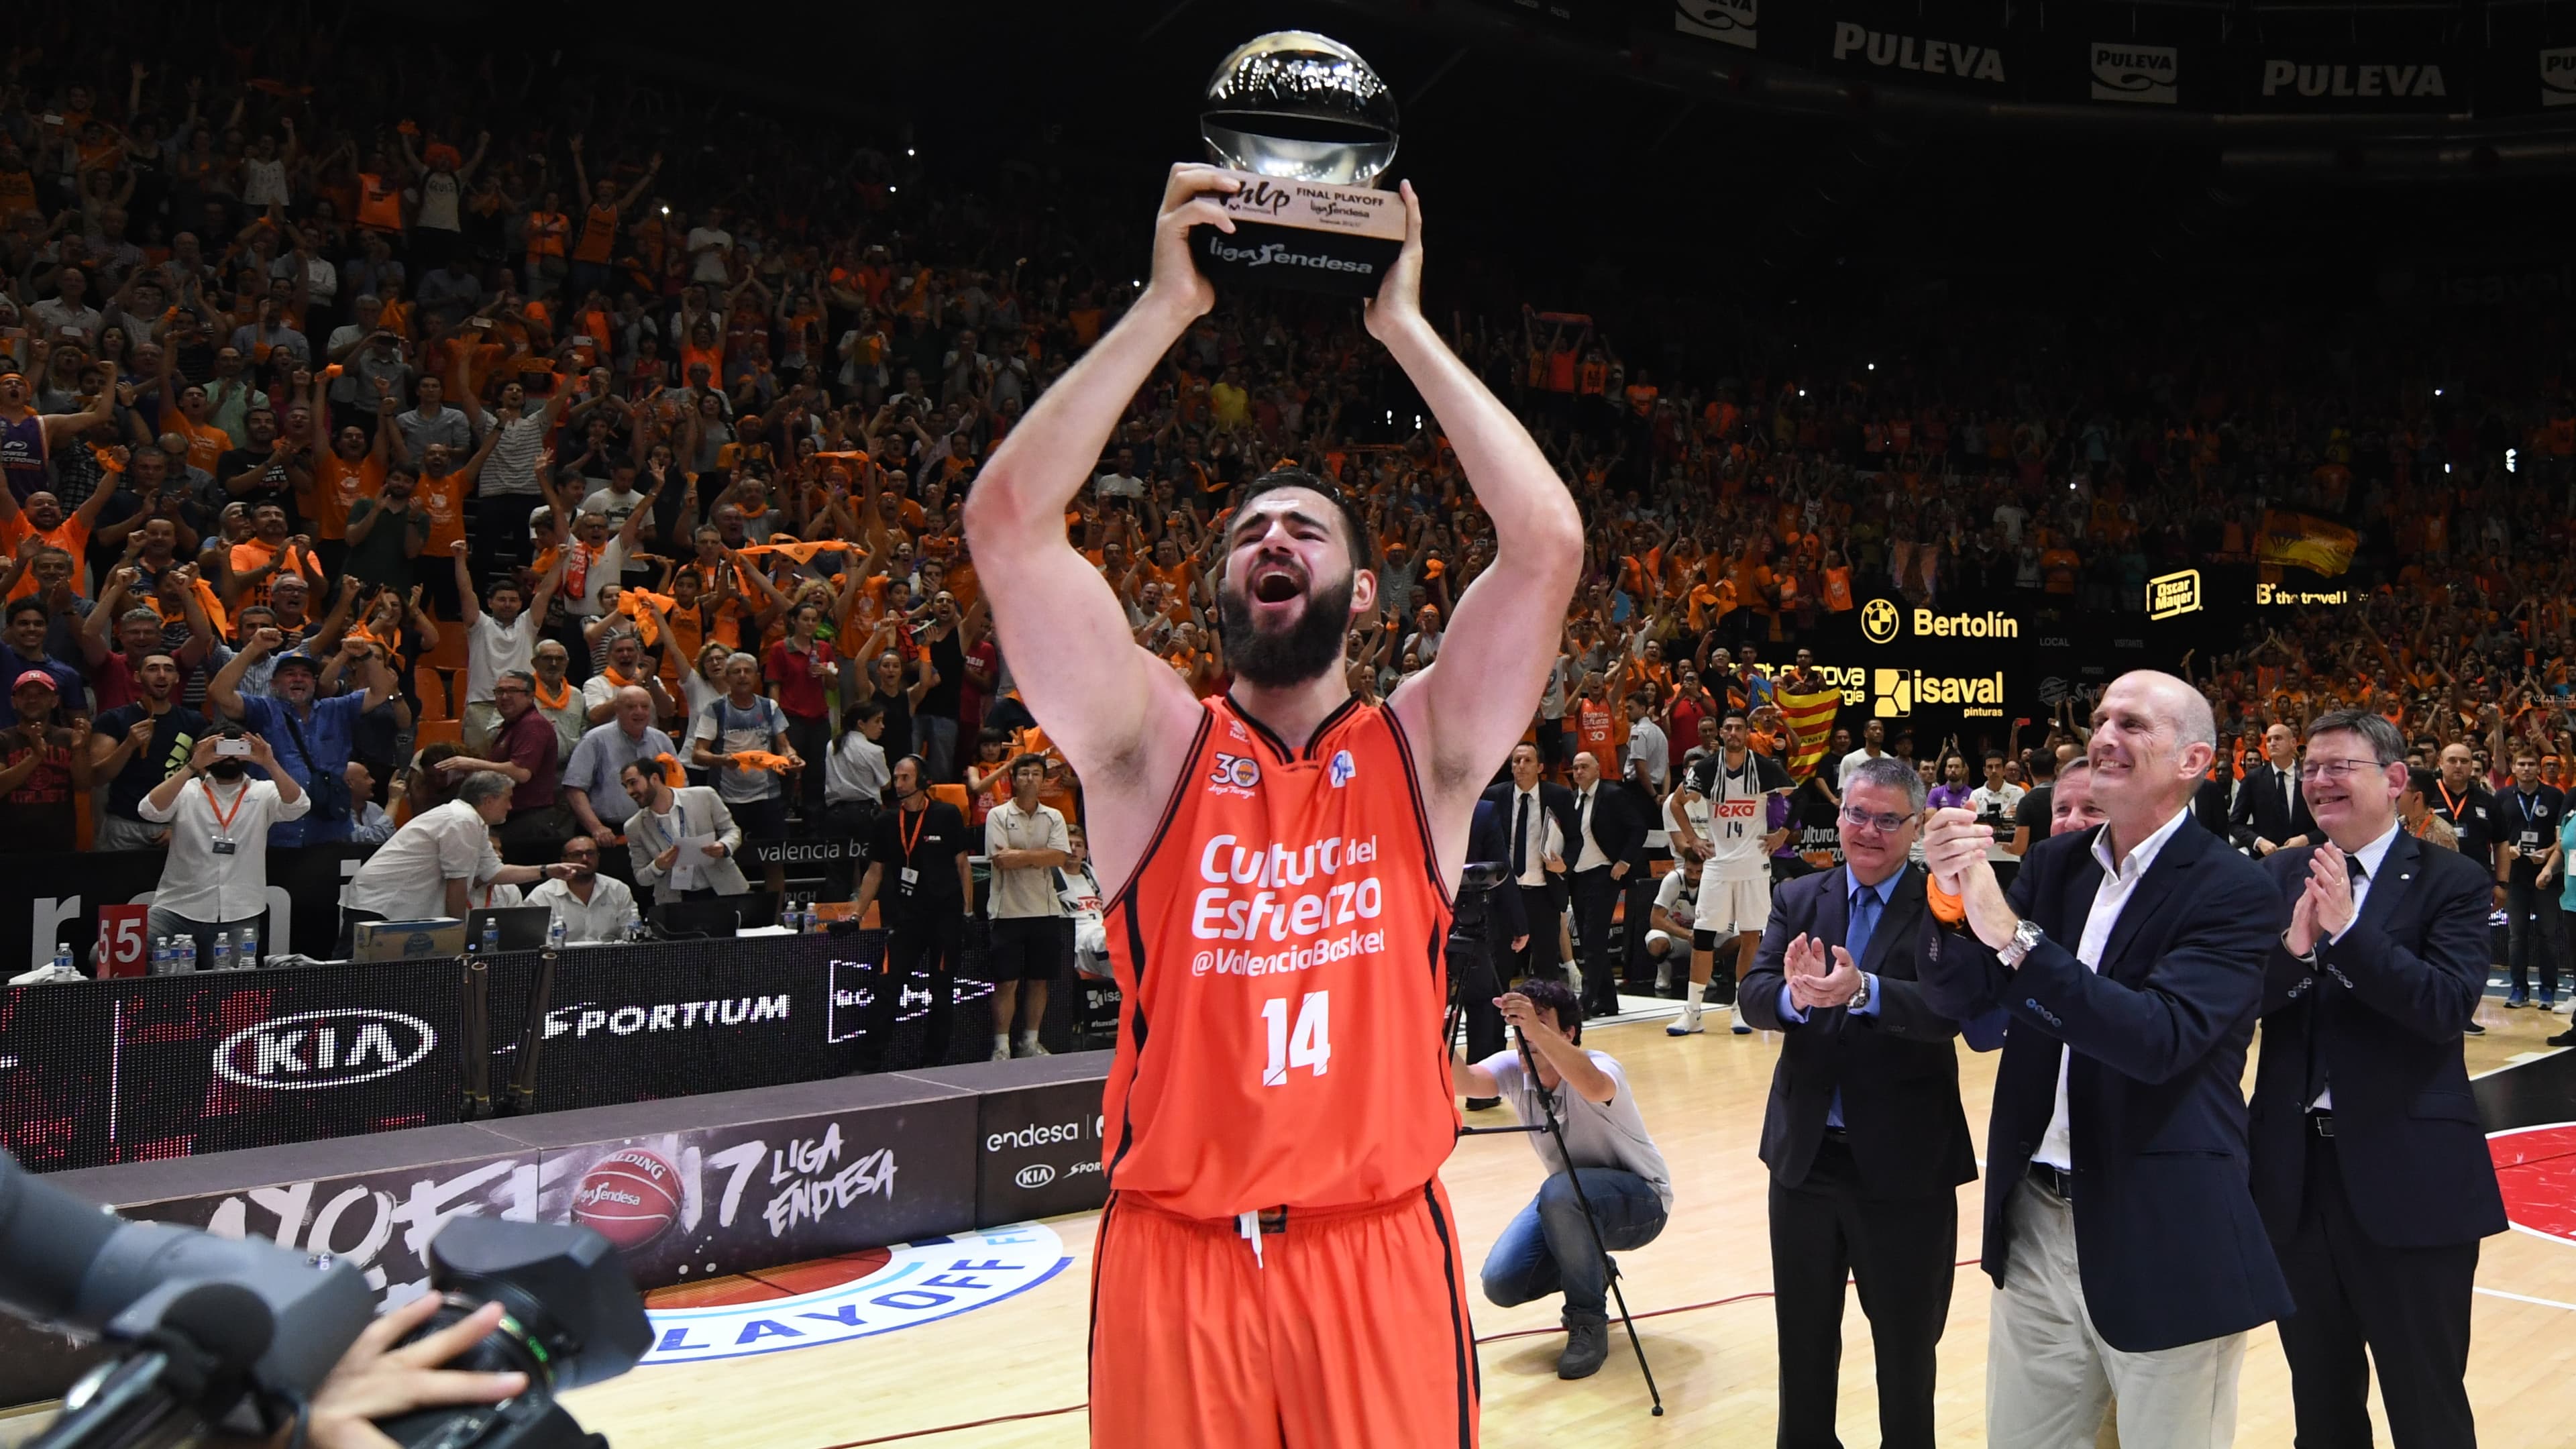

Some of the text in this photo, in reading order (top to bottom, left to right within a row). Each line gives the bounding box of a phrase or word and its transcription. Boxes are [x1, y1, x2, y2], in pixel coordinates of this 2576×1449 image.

[1833, 21, 2006, 83] PULEVA
[2096, 50, 2173, 70] PULEVA
[2261, 60, 2447, 97] PULEVA
[1296, 187, 1384, 207] FINAL PLAYOFF
[2155, 591, 2193, 611] Mayer
[2157, 580, 2190, 598] Oscar
[1914, 608, 2018, 638] Bertolín
[2039, 637, 2070, 647] LOCAL
[1914, 669, 2003, 704] isaval
[1964, 707, 2003, 718] pinturas
[1590, 731, 1605, 741] 30
[1210, 752, 1260, 788] 30
[1726, 821, 1743, 839] 14
[757, 840, 841, 861] valencia
[1199, 835, 1377, 888] Cultura del
[1191, 877, 1382, 943] Esfuerzo
[1191, 928, 1385, 977] @ValenciaBasket
[257, 1022, 398, 1075] KIA
[1261, 991, 1331, 1087] 14
[987, 1122, 1079, 1152] endesa
[771, 1122, 845, 1185] LIGA
[1022, 1169, 1048, 1185] KIA
[763, 1147, 898, 1238] ENDESA
